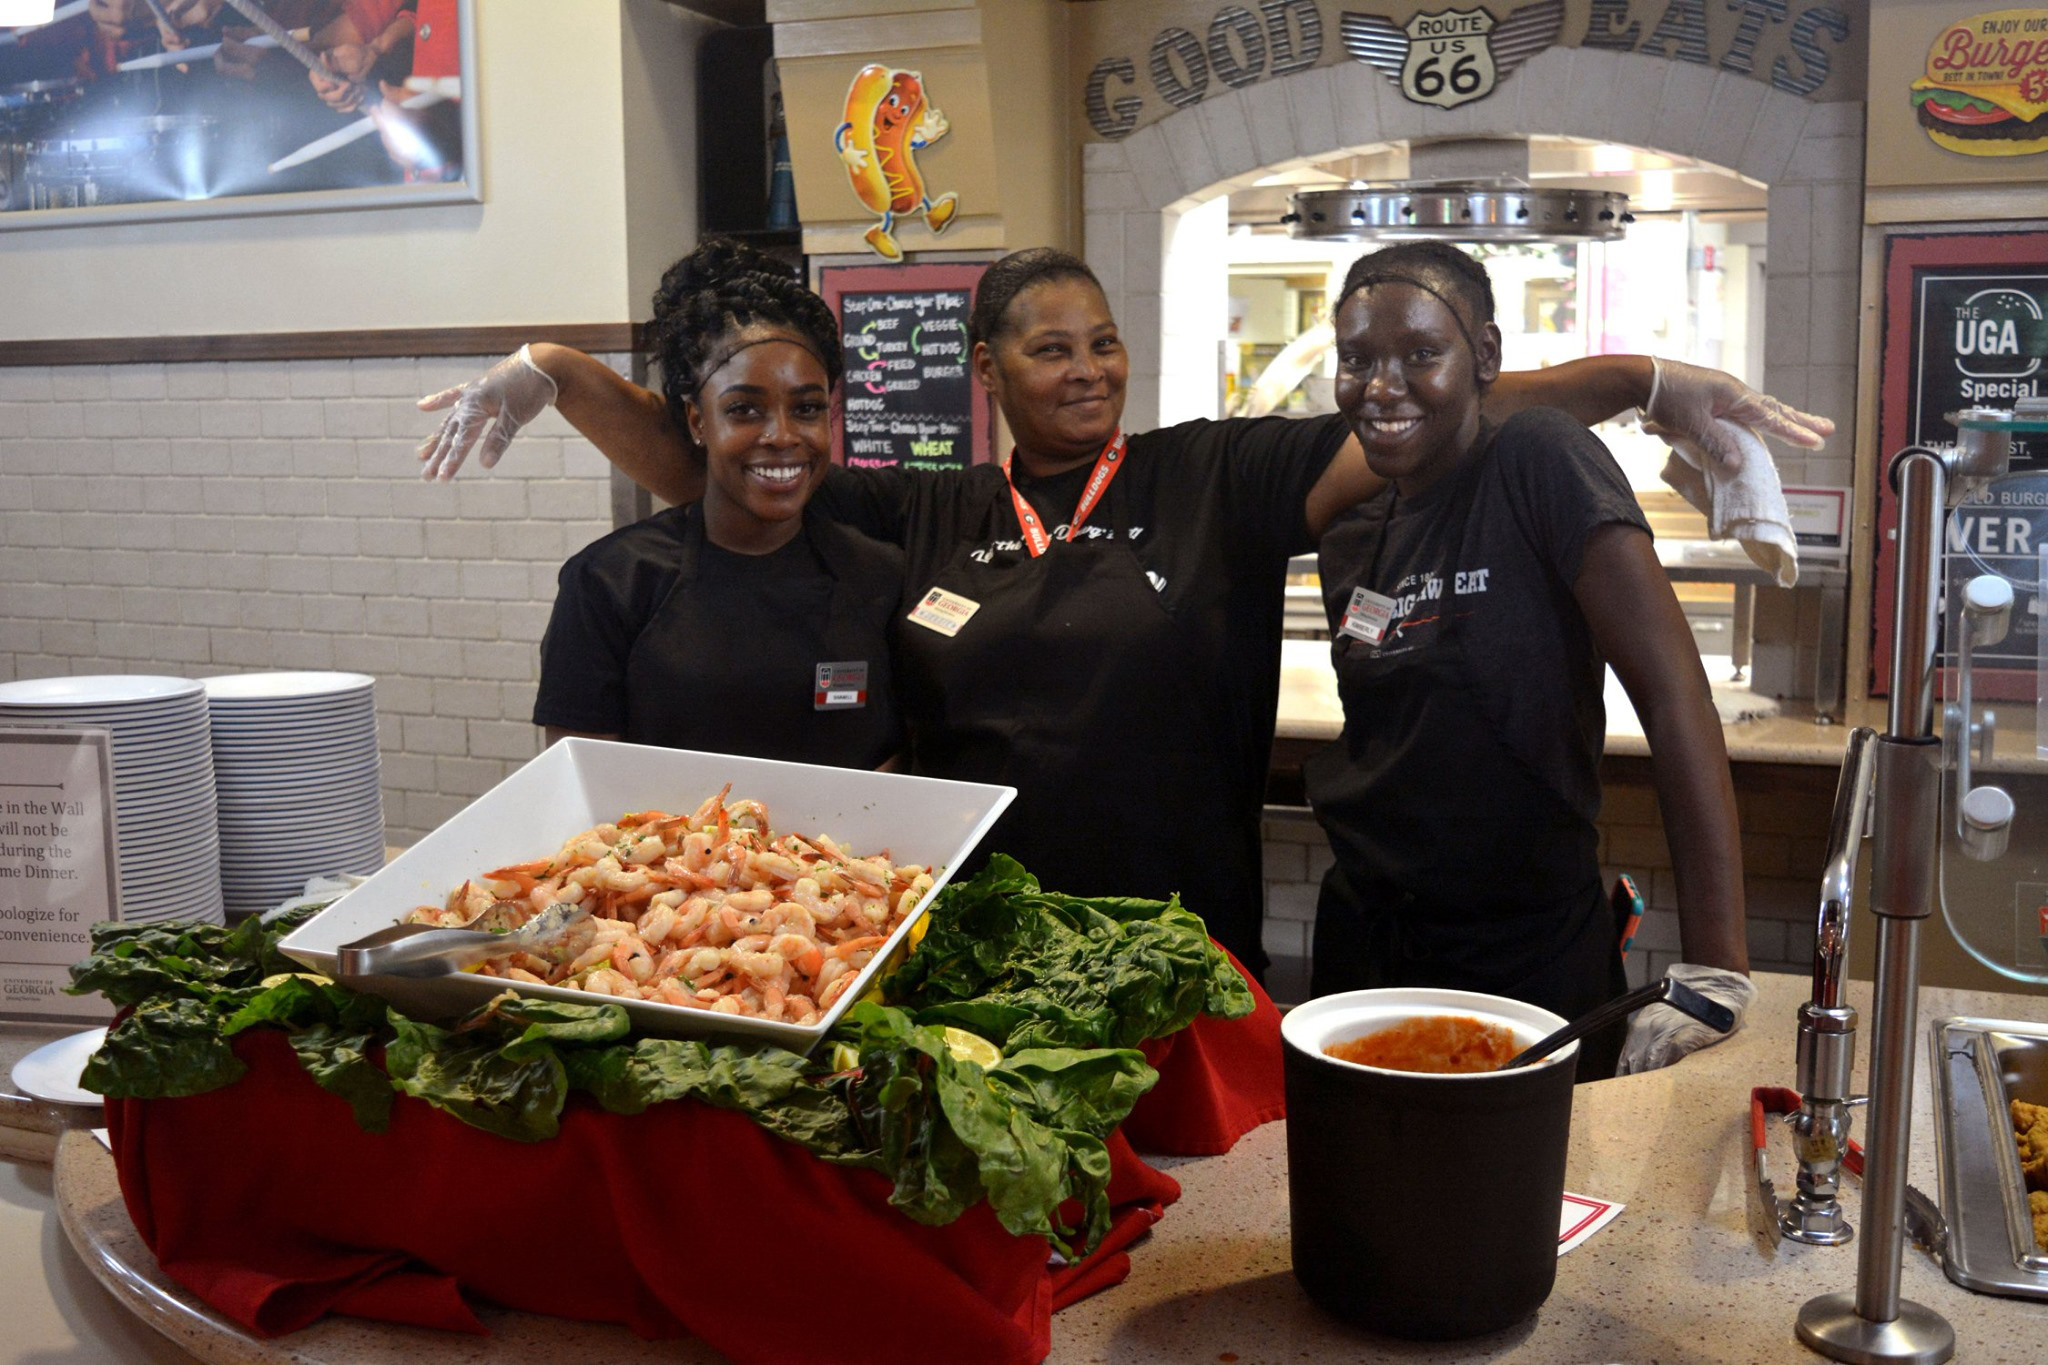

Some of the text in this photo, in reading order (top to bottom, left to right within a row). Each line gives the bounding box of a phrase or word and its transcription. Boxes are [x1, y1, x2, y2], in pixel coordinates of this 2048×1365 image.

[1418, 17, 1482, 36] ROUTE
[1982, 18, 2048, 34] ENJOY OUR
[1430, 40, 1466, 55] US
[1085, 0, 1848, 139] GOOD EATS
[1415, 54, 1481, 97] 66
[1955, 307, 1980, 319] THE
[877, 318, 900, 331] BEEF
[921, 318, 959, 332] VEGGIE
[1955, 319, 2019, 355] UGA
[876, 341, 908, 353] TURKEY
[922, 365, 964, 379] BURGER
[1960, 378, 2038, 402] Special
[851, 439, 894, 454] WHITE
[909, 440, 954, 456] WHEAT
[1080, 464, 1110, 513] BULLDOGS
[1454, 568, 1490, 595] EAT
[7, 801, 20, 814] in
[24, 800, 48, 815] the
[51, 801, 84, 816] Wall
[23, 824, 47, 837] not
[51, 822, 69, 837] be
[49, 845, 72, 858] the
[25, 865, 79, 880] Dinner.
[60, 908, 80, 922] for
[4, 983, 56, 996] GEORGIA
